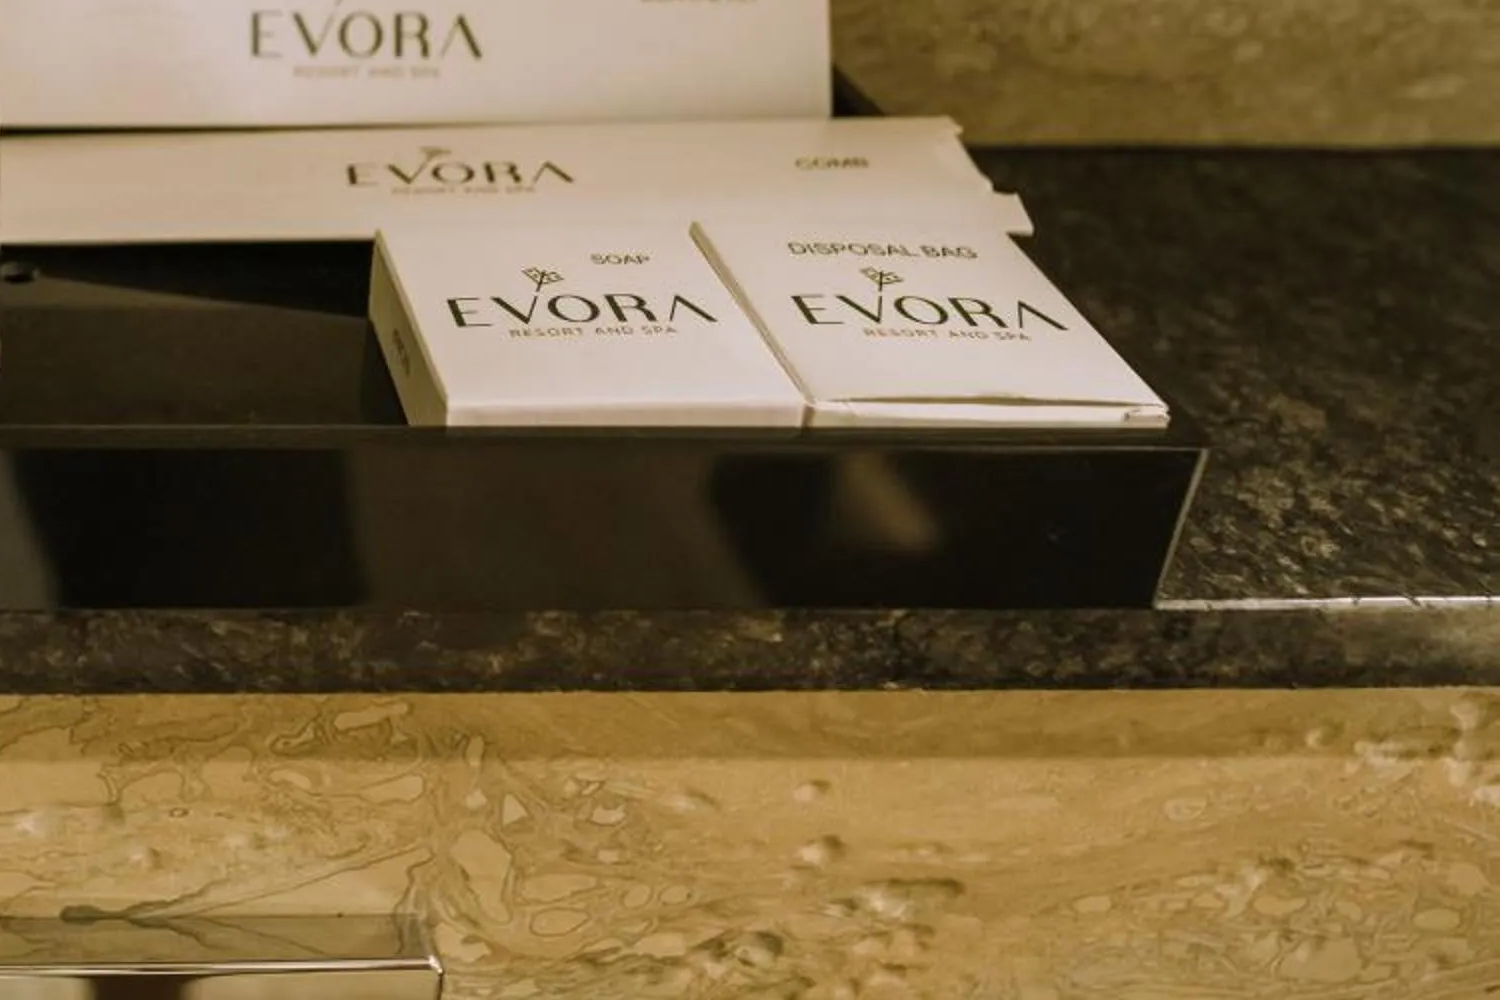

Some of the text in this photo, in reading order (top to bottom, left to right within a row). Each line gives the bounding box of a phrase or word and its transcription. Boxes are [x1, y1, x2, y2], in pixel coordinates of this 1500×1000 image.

[250, 10, 483, 61] EVORA
[347, 161, 575, 186] EVORA
[591, 253, 651, 265] SOAP
[787, 242, 978, 259] DISPOSAL BAG
[447, 294, 718, 328] EVORA
[790, 294, 1069, 332] EVORA
[510, 325, 678, 338] RESORT AND SPA
[863, 327, 1031, 342] RESORT AND SPA
